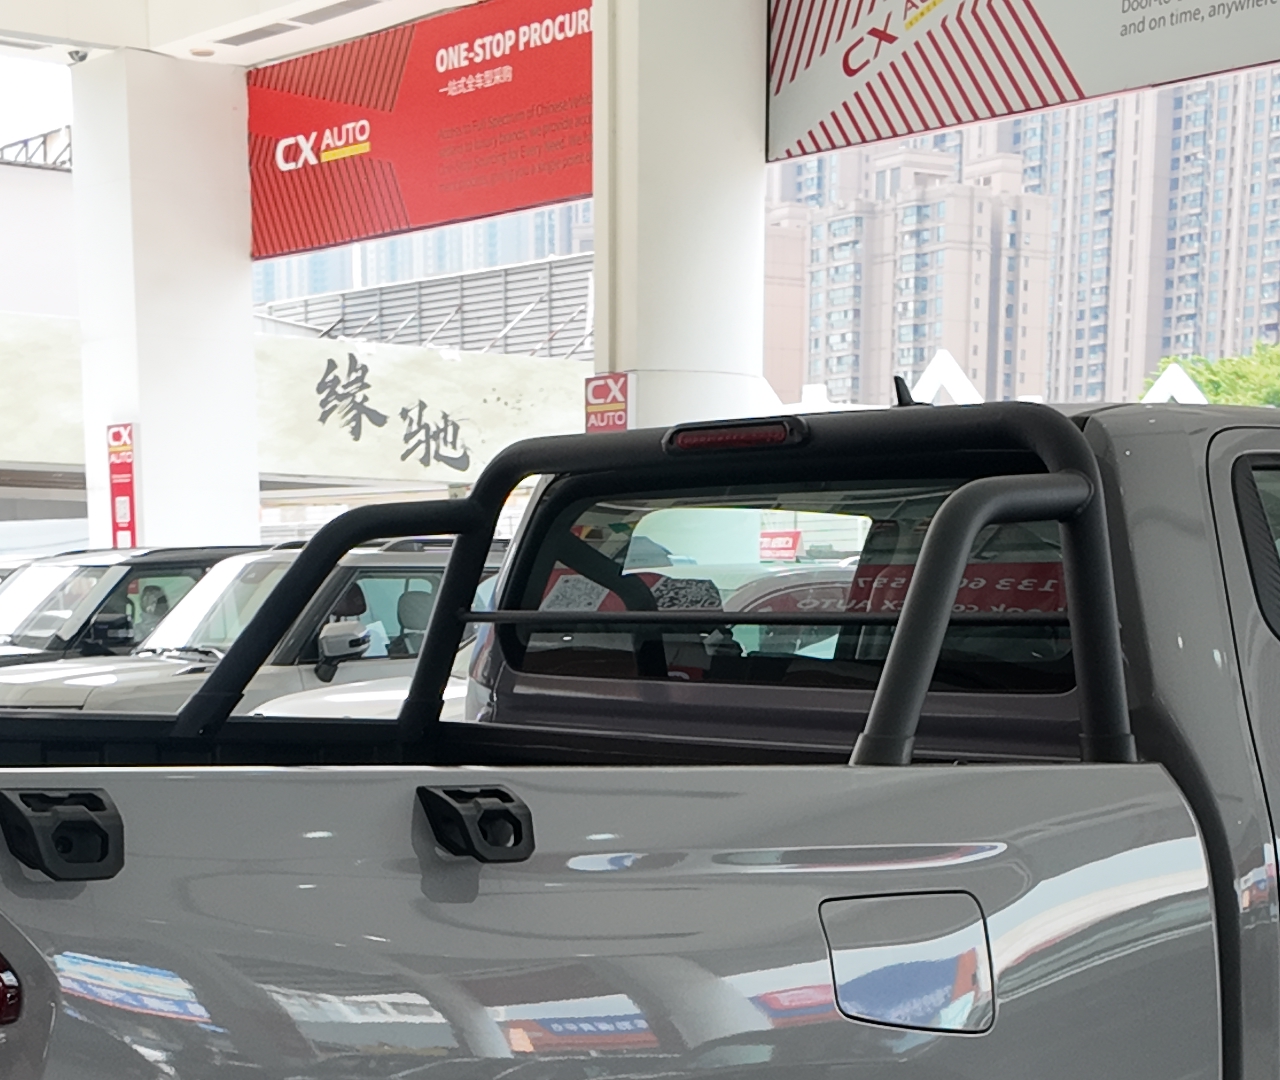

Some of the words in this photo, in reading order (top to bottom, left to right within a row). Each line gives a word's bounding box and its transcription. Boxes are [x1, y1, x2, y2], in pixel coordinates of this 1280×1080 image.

[1120, 16, 1146, 37] and
[1148, 16, 1167, 31] on
[1170, 7, 1205, 27] time,
[435, 29, 516, 74] ONE-STOP
[518, 6, 594, 52] PROCUR
[842, 10, 899, 77] CX
[275, 131, 319, 172] CX
[320, 119, 371, 151] AUTO
[587, 377, 626, 405] CX
[587, 411, 626, 428] AUTO
[108, 426, 132, 446] CX
[110, 451, 133, 463] AUTO
